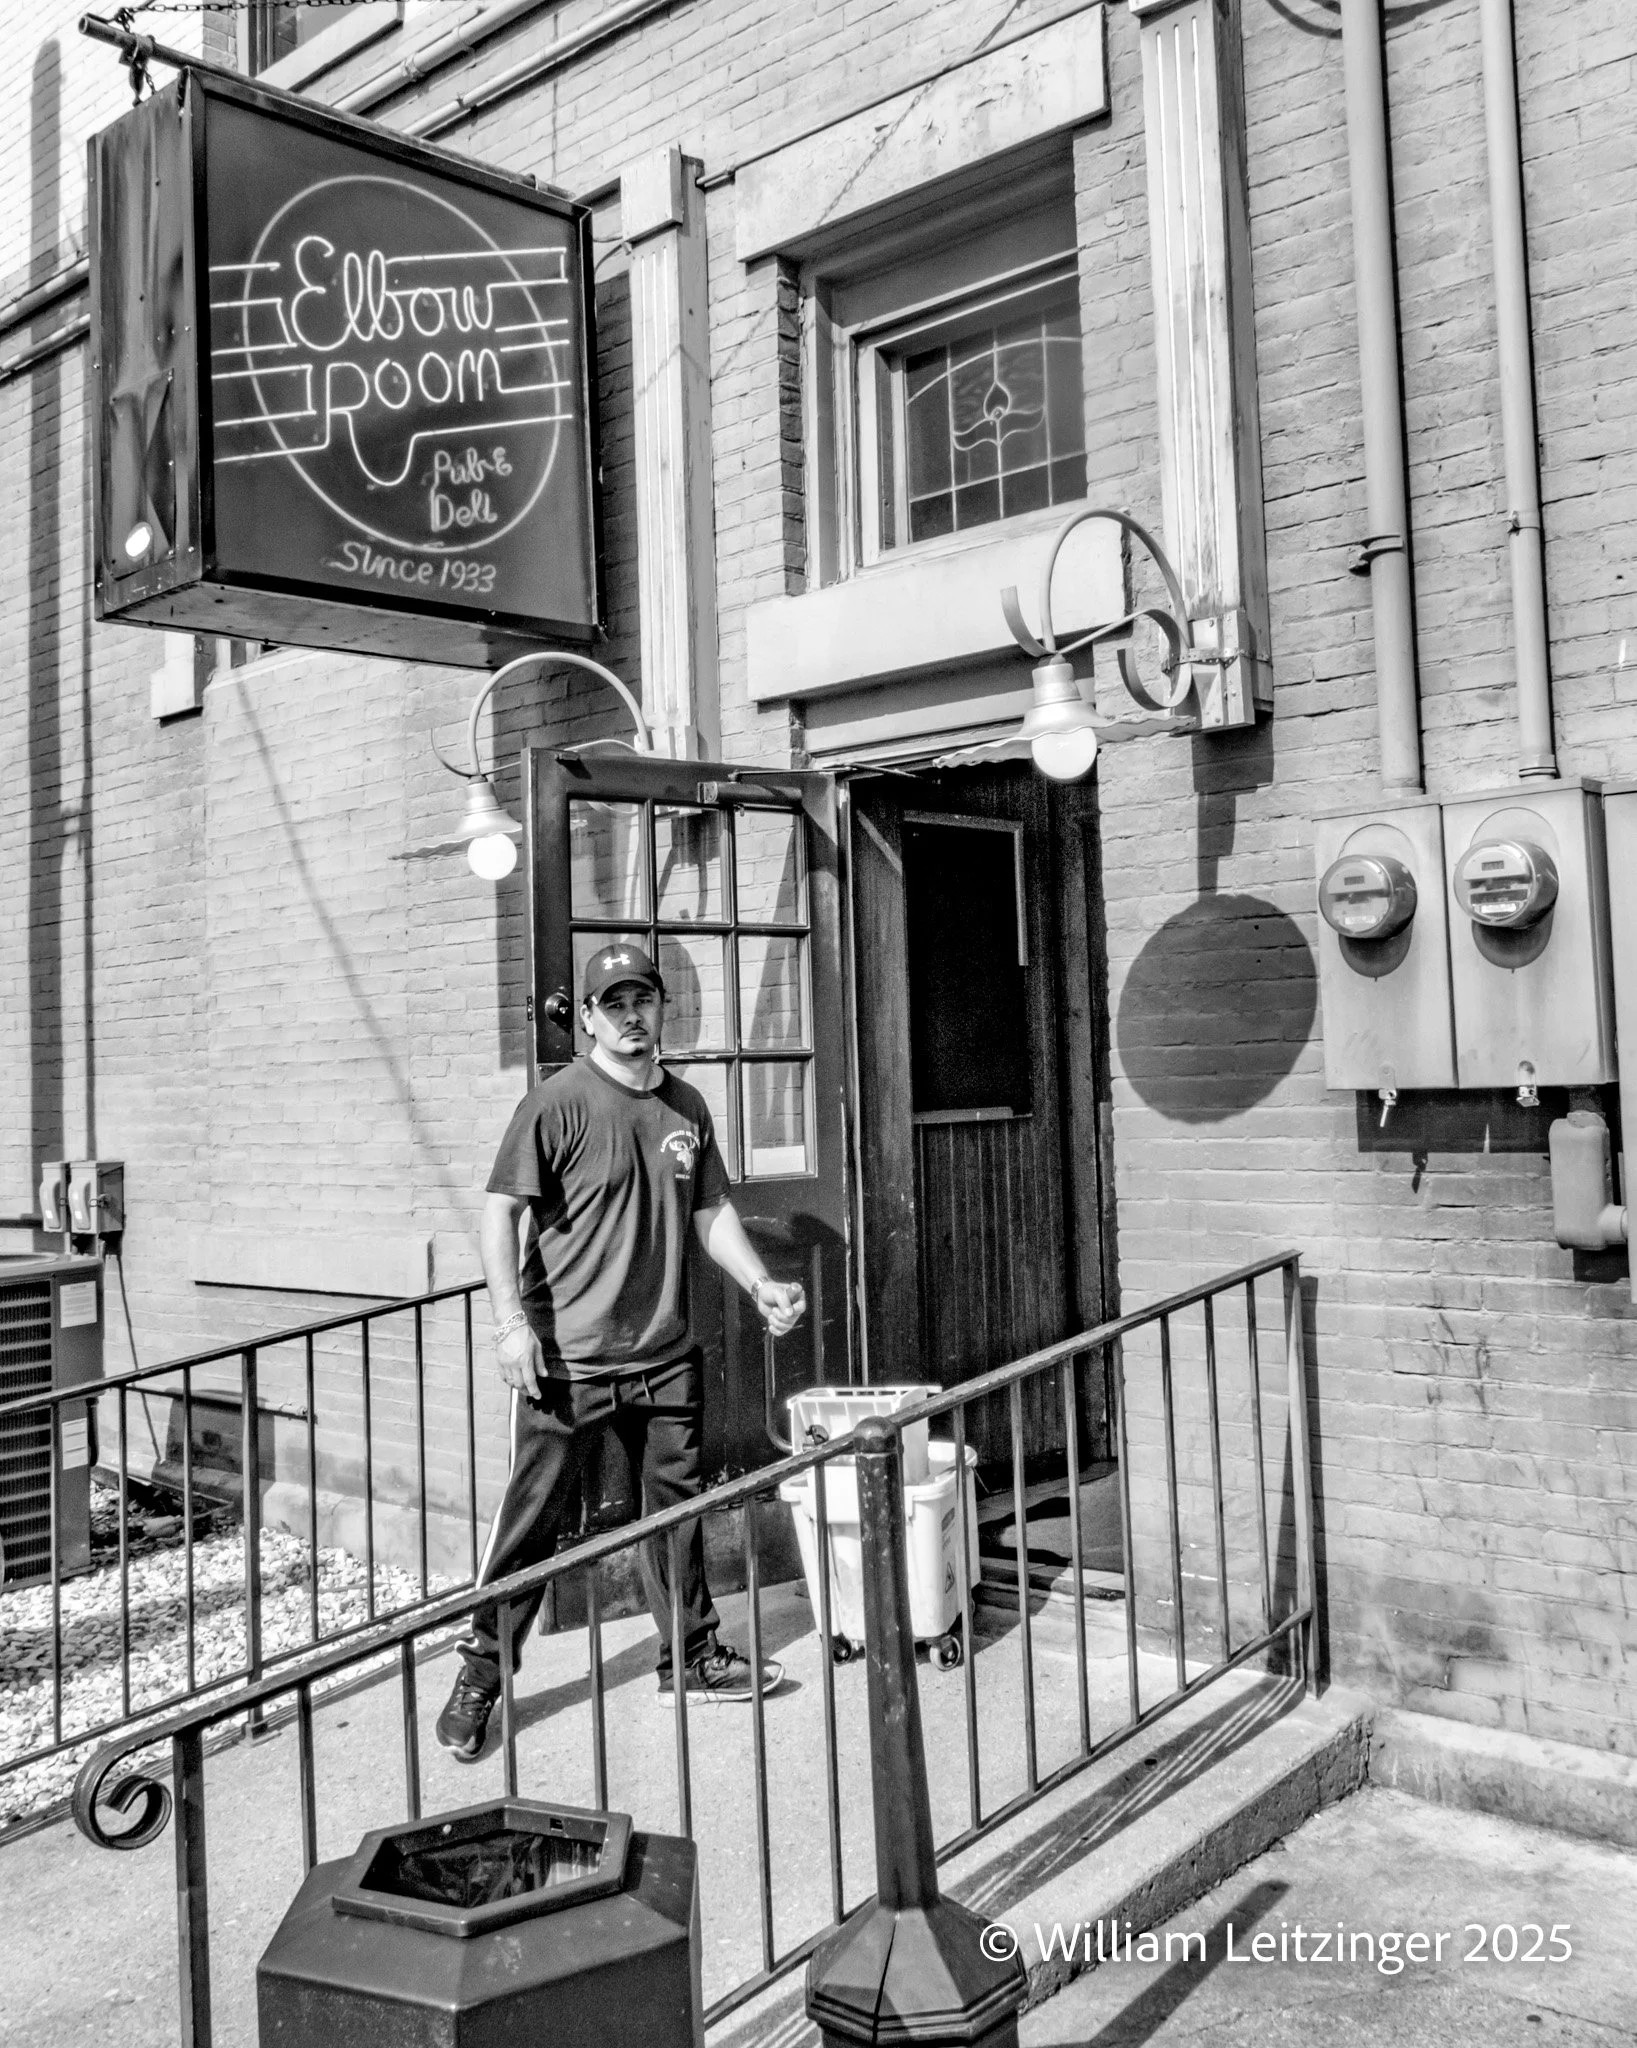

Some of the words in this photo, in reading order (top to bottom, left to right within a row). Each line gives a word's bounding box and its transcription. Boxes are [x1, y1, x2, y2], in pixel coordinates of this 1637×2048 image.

[291, 234, 493, 351] Elbow
[325, 348, 502, 456] Room
[433, 447, 494, 488] Pub
[328, 541, 434, 585] Since
[439, 558, 497, 592] 1933
